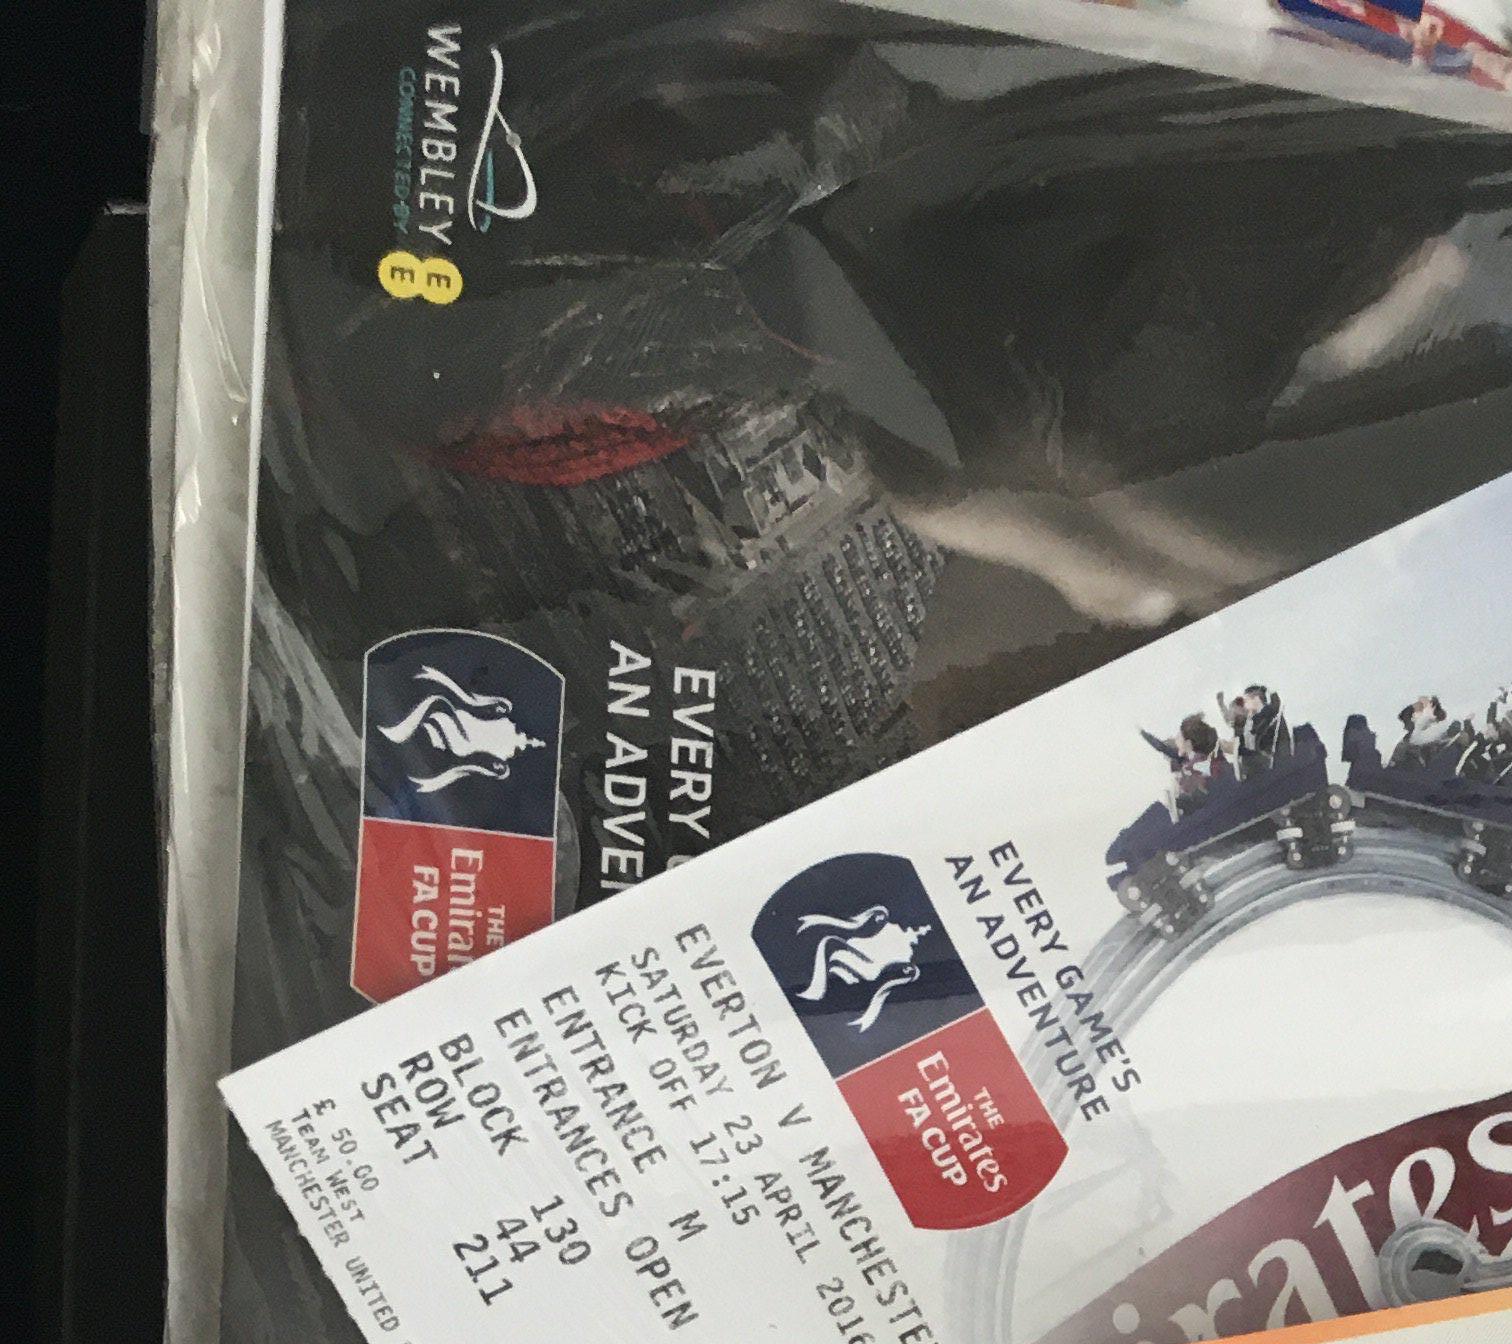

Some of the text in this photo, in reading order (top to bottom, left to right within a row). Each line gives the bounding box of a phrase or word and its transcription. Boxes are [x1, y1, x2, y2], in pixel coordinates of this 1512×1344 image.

[418, 23, 462, 246] WEMBLEY
[600, 640, 652, 892] AN ADVE
[668, 666, 717, 838] EVERY
[410, 865, 440, 976] FA CUP
[675, 922, 787, 1090] EVERTON
[777, 1103, 812, 1129] V
[945, 853, 1111, 1122] AN ADVENTURE
[988, 840, 1142, 1093] EVERY GAME'S
[290, 1109, 365, 1224] TEAM WEST
[361, 1072, 513, 1307] SEAT 211
[398, 1051, 541, 1264] ROW 44
[438, 1033, 592, 1266] BLOCK 130
[493, 1008, 635, 1220] ENTRANCES
[624, 1235, 699, 1330] OPEN
[541, 984, 709, 1243] ENTRANCE M
[595, 960, 761, 1227] KICK OFF 17:15
[630, 947, 734, 1097] SATURDAY
[724, 1115, 763, 1156] 23
[754, 1170, 822, 1265] APRIL
[897, 1087, 969, 1189] FA CUP
[916, 1051, 1009, 1193] Emirates
[973, 1087, 1007, 1129] THE
